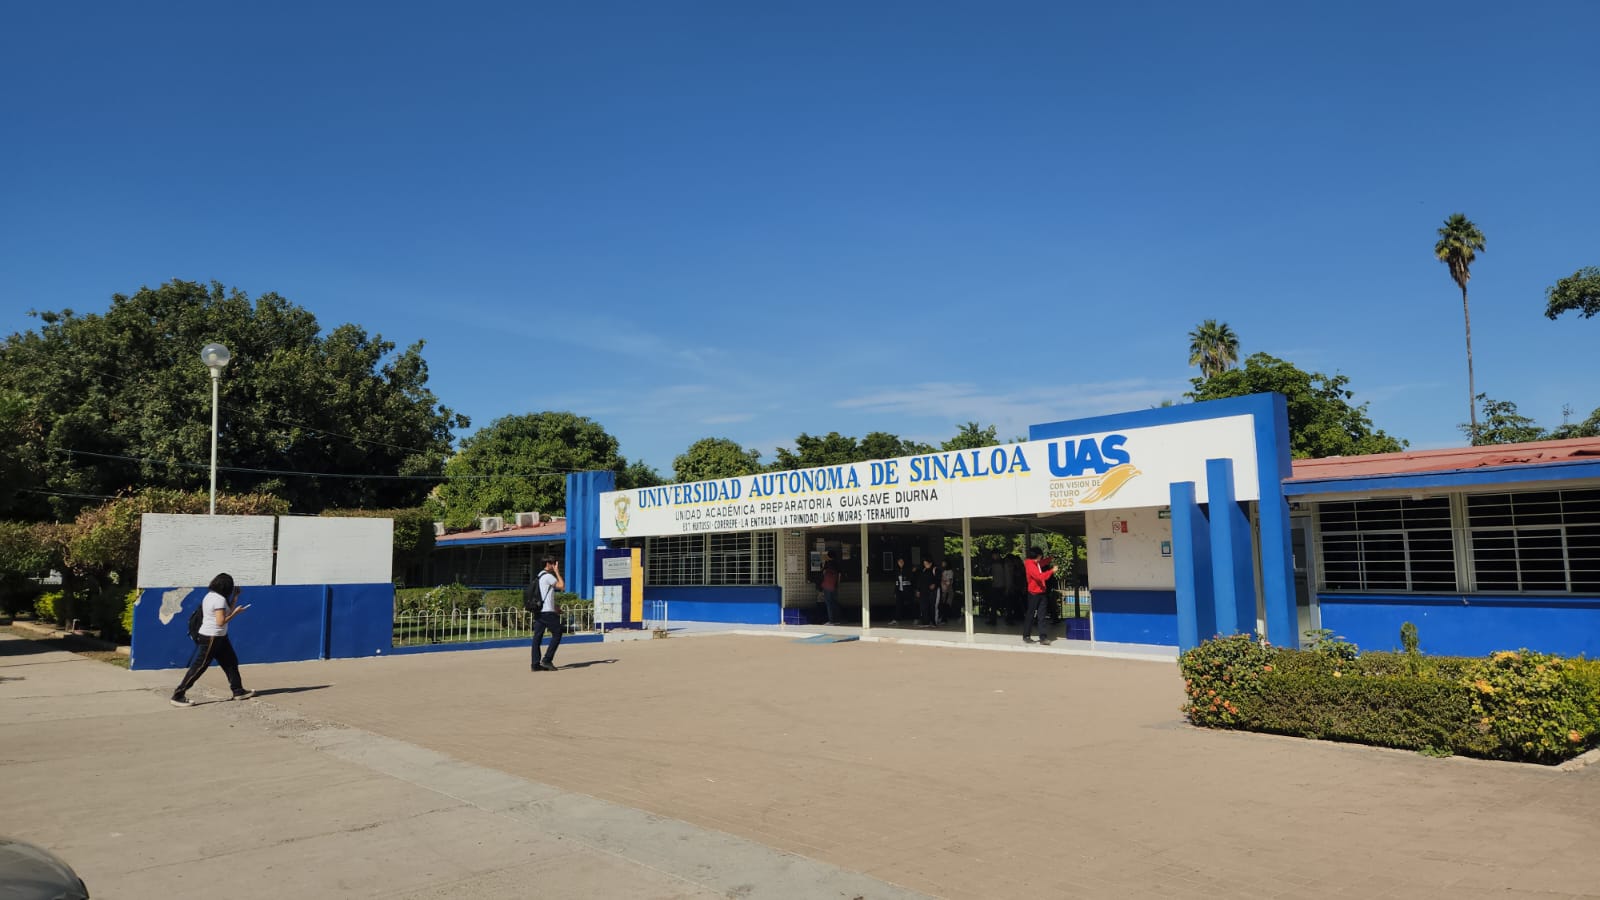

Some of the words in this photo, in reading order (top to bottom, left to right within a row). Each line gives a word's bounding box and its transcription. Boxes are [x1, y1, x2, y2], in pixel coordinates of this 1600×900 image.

[1048, 434, 1131, 478] UAS
[638, 478, 742, 508] UNIVERSIDAD
[870, 460, 899, 487] DE
[910, 445, 1031, 483] SINALOA
[1049, 482, 1064, 490] CON
[1066, 480, 1090, 489] VISION
[1092, 479, 1101, 487] DE
[675, 508, 701, 521] UNIDAD
[705, 503, 755, 518] ACADÉMICA
[760, 497, 833, 514] PREPARATORIA
[839, 492, 890, 508] GUASAVE
[895, 488, 938, 504] DIURNA
[1049, 489, 1080, 498] FUTURO
[1050, 498, 1074, 508] 2025
[741, 517, 749, 528] LA
[750, 515, 777, 527] ENTRADA
[780, 514, 788, 525] LA
[790, 512, 818, 525] TRINIDAD
[823, 511, 834, 523] LAS
[837, 509, 862, 522] MORAS
[866, 506, 910, 520] TERAHUITO
